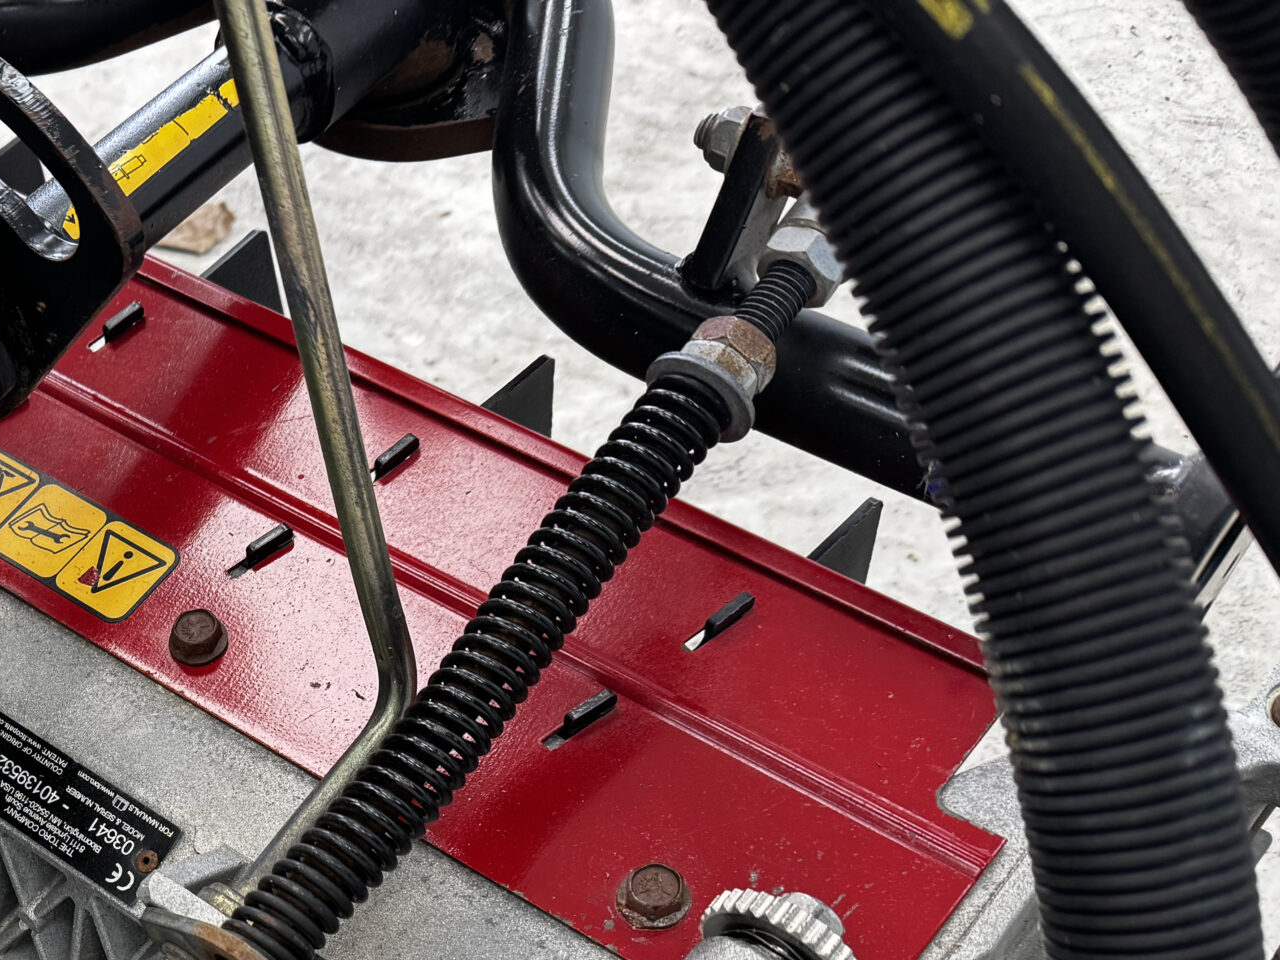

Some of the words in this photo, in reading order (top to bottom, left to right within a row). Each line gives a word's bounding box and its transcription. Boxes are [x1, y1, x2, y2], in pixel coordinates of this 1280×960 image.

[0, 729, 23, 748] ORIGIN:
[22, 746, 32, 755] OF
[41, 747, 68, 768] PATENT:
[31, 752, 63, 775] COUNTRY
[0, 779, 15, 794] USA
[77, 770, 115, 798] www.toro.com
[5, 794, 23, 810] South
[13, 790, 50, 818] 55420-1196
[65, 785, 94, 807] NUMBER
[3, 806, 39, 832] COMPANY
[22, 806, 47, 826] Avenue
[48, 814, 62, 827] MN
[93, 802, 116, 822] SERIAL
[128, 804, 160, 828] MANUALS
[38, 828, 59, 847] TORO
[45, 821, 71, 843] Lyndale
[63, 821, 102, 854] Bloomington,
[88, 817, 135, 856] 03641
[120, 821, 145, 841] MODEL
[158, 823, 174, 838] FOR
[58, 842, 74, 857] THE
[69, 839, 86, 853] 8111
